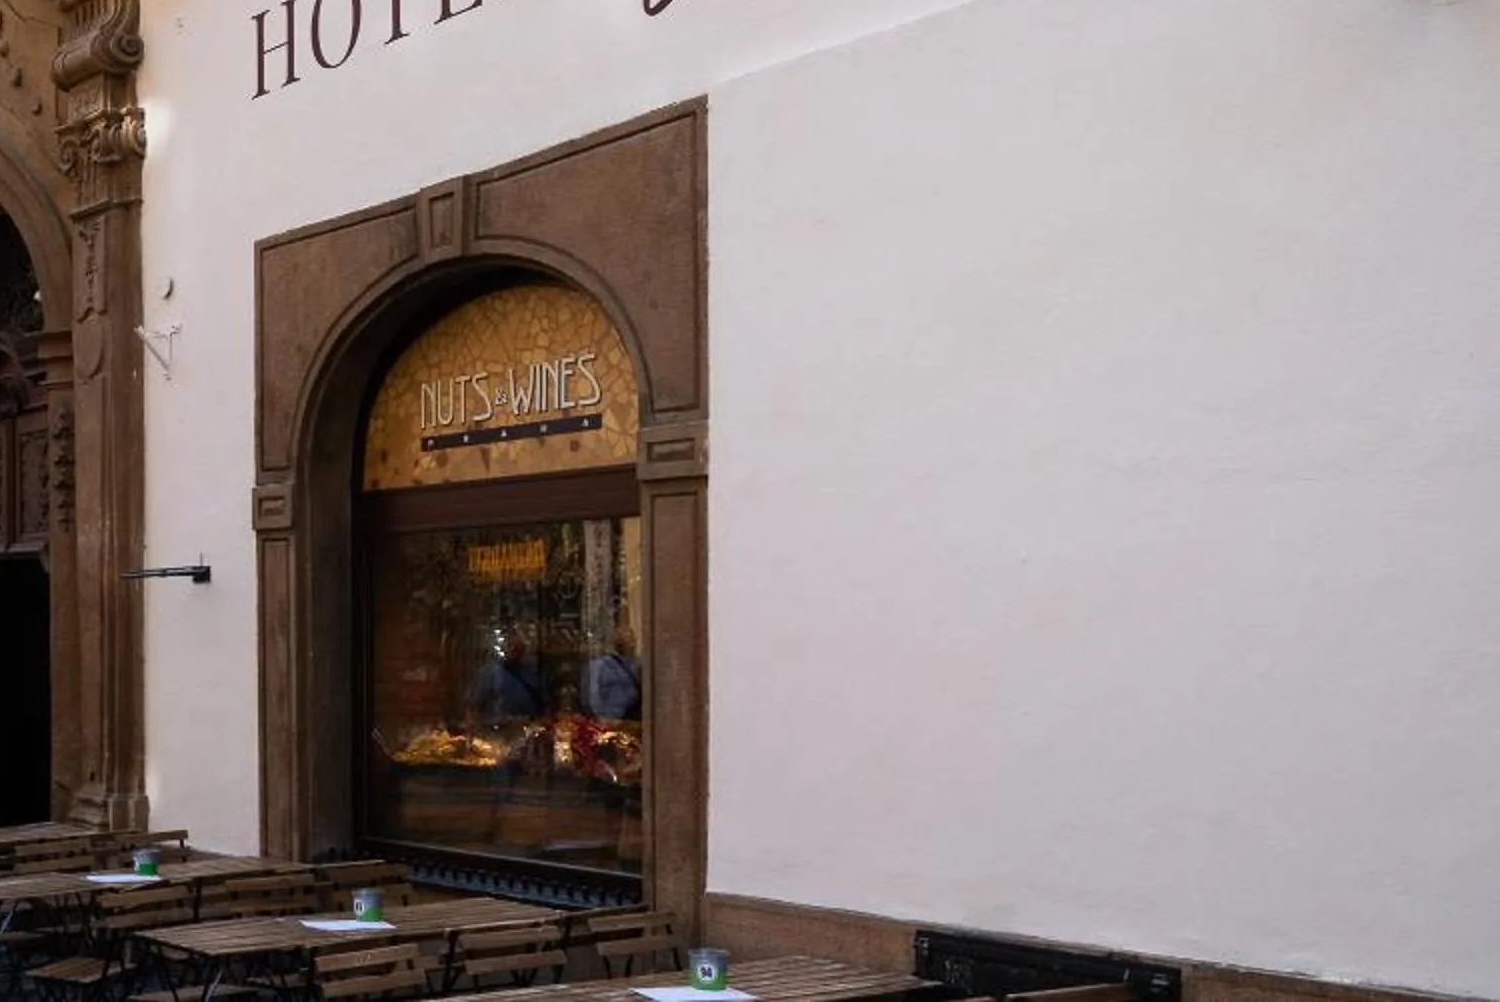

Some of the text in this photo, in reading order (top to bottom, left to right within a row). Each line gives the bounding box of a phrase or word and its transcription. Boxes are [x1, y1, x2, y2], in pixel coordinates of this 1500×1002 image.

[420, 352, 602, 430] NUTS & WINES
